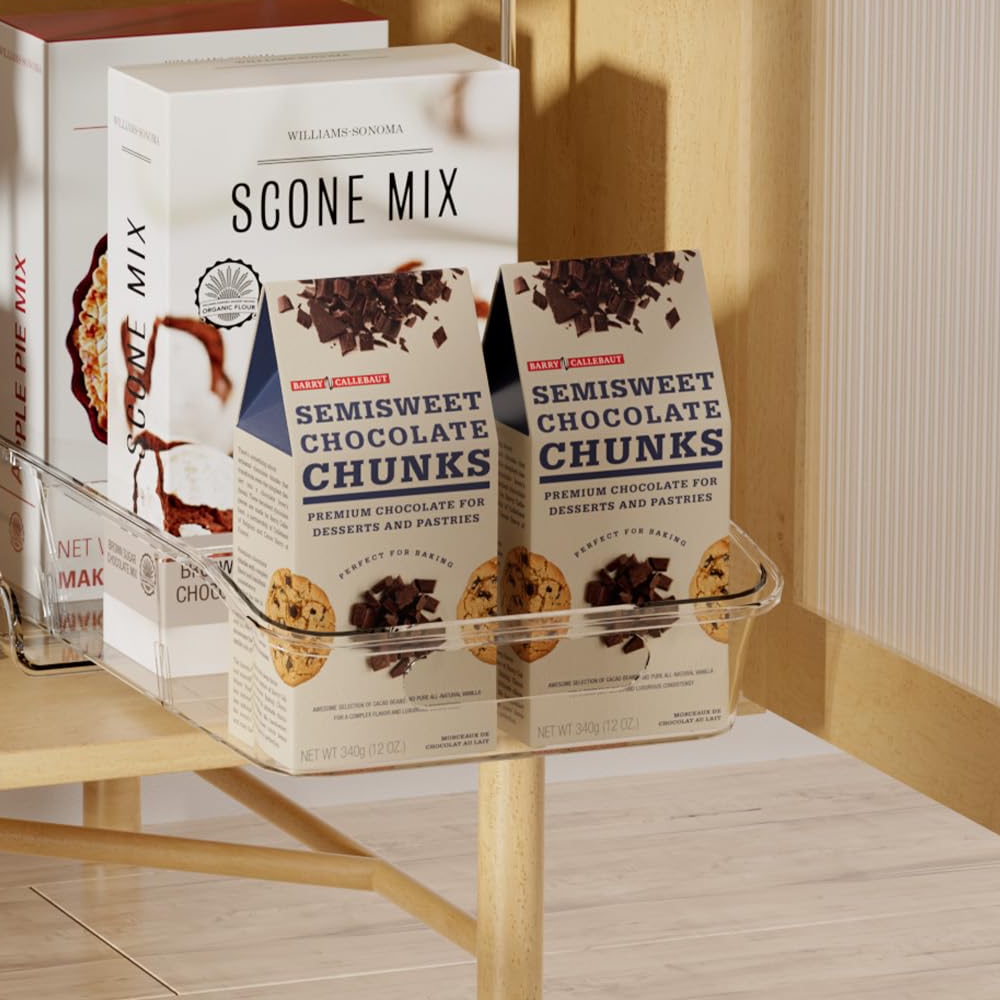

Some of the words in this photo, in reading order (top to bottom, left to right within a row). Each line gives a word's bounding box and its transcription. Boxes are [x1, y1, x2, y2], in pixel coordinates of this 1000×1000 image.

[231, 174, 365, 233] SCONE
[389, 168, 458, 221] MIX
[127, 217, 147, 297] MIX
[15, 254, 27, 314] MIX
[15, 322, 27, 372] PIE
[529, 360, 560, 370] BARRY
[570, 355, 623, 367] CALLEBAUT
[127, 315, 146, 459] SCONE
[293, 380, 324, 390] BARRY
[334, 375, 388, 387] CALLEBAUT
[532, 371, 714, 405] SEMISWEET
[296, 391, 481, 425] SEMISWEET
[537, 400, 721, 434] CHOCOLATE
[300, 420, 489, 454] CHOCOLATE
[539, 428, 723, 470] CHUNKS
[303, 449, 490, 491] CHUNKS
[544, 486, 606, 500] PREMIUM
[610, 480, 688, 495] CHOCOLATE
[692, 476, 718, 488] FOR
[549, 501, 615, 516] DESSERTS
[619, 499, 647, 510] AND
[651, 493, 713, 507] PASTRIES
[307, 508, 371, 522] PREMIUM
[376, 502, 455, 516] CHOCOLATE
[459, 497, 485, 508] FOR
[312, 523, 380, 537] DESSERTS
[384, 520, 412, 531] AND
[416, 513, 480, 528] PASTRIES
[58, 537, 89, 560] NET
[389, 549, 410, 557] FOR
[537, 725, 556, 739] NET
[558, 723, 573, 737] WT
[575, 720, 600, 737] 340g
[300, 748, 320, 762] NET
[323, 746, 337, 760] WT
[340, 743, 367, 761] 340g
